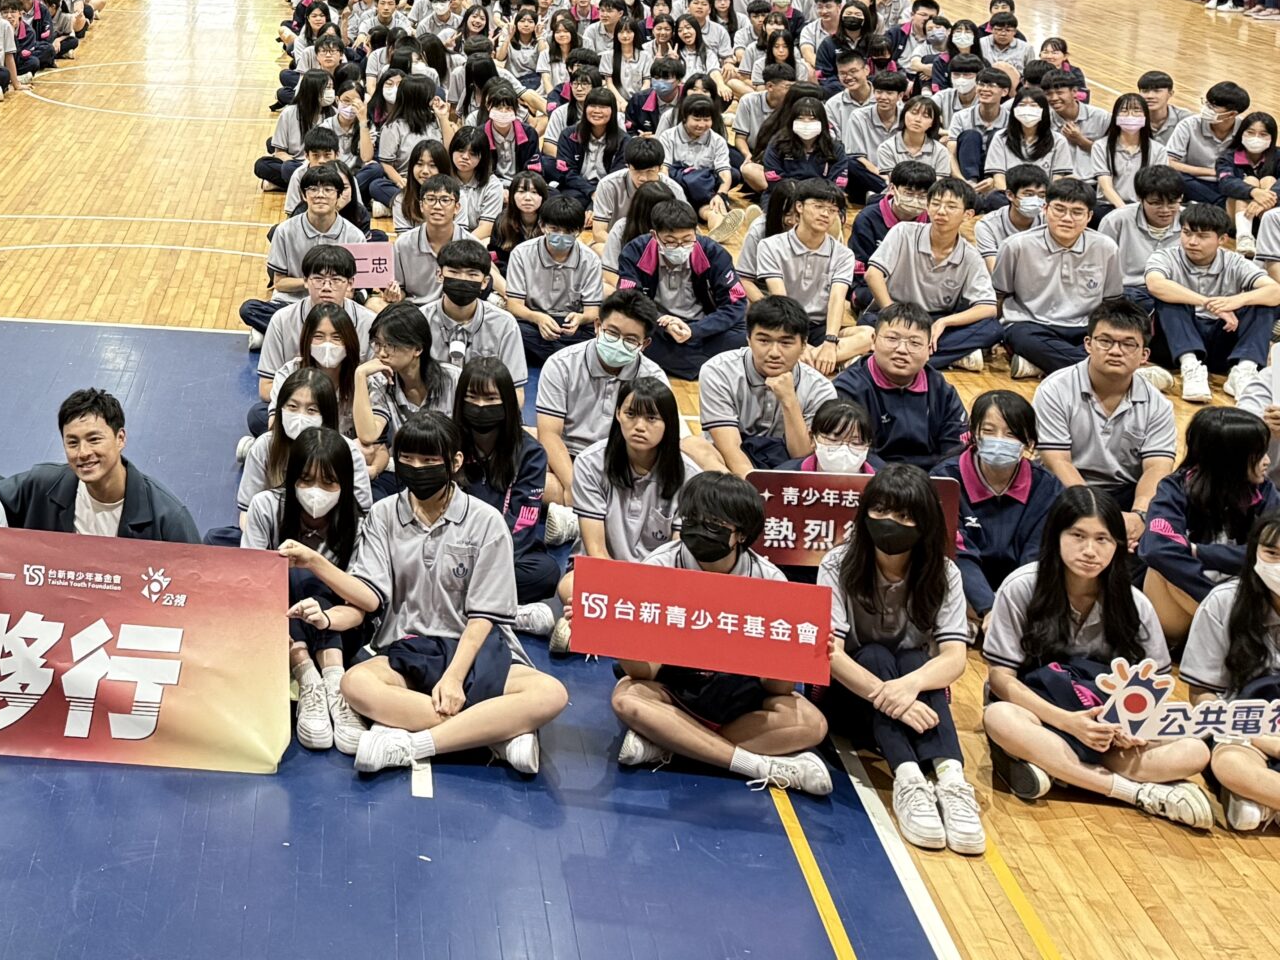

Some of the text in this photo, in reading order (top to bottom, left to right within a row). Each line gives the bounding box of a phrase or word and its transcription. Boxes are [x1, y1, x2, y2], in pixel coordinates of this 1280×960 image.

[764, 517, 857, 550] 熱烈
[48, 569, 121, 585] 台新青少年基金會
[48, 578, 122, 591] Taishin Youth Foundation
[162, 593, 188, 607] 公視
[614, 598, 819, 645] 台新青少年基金會
